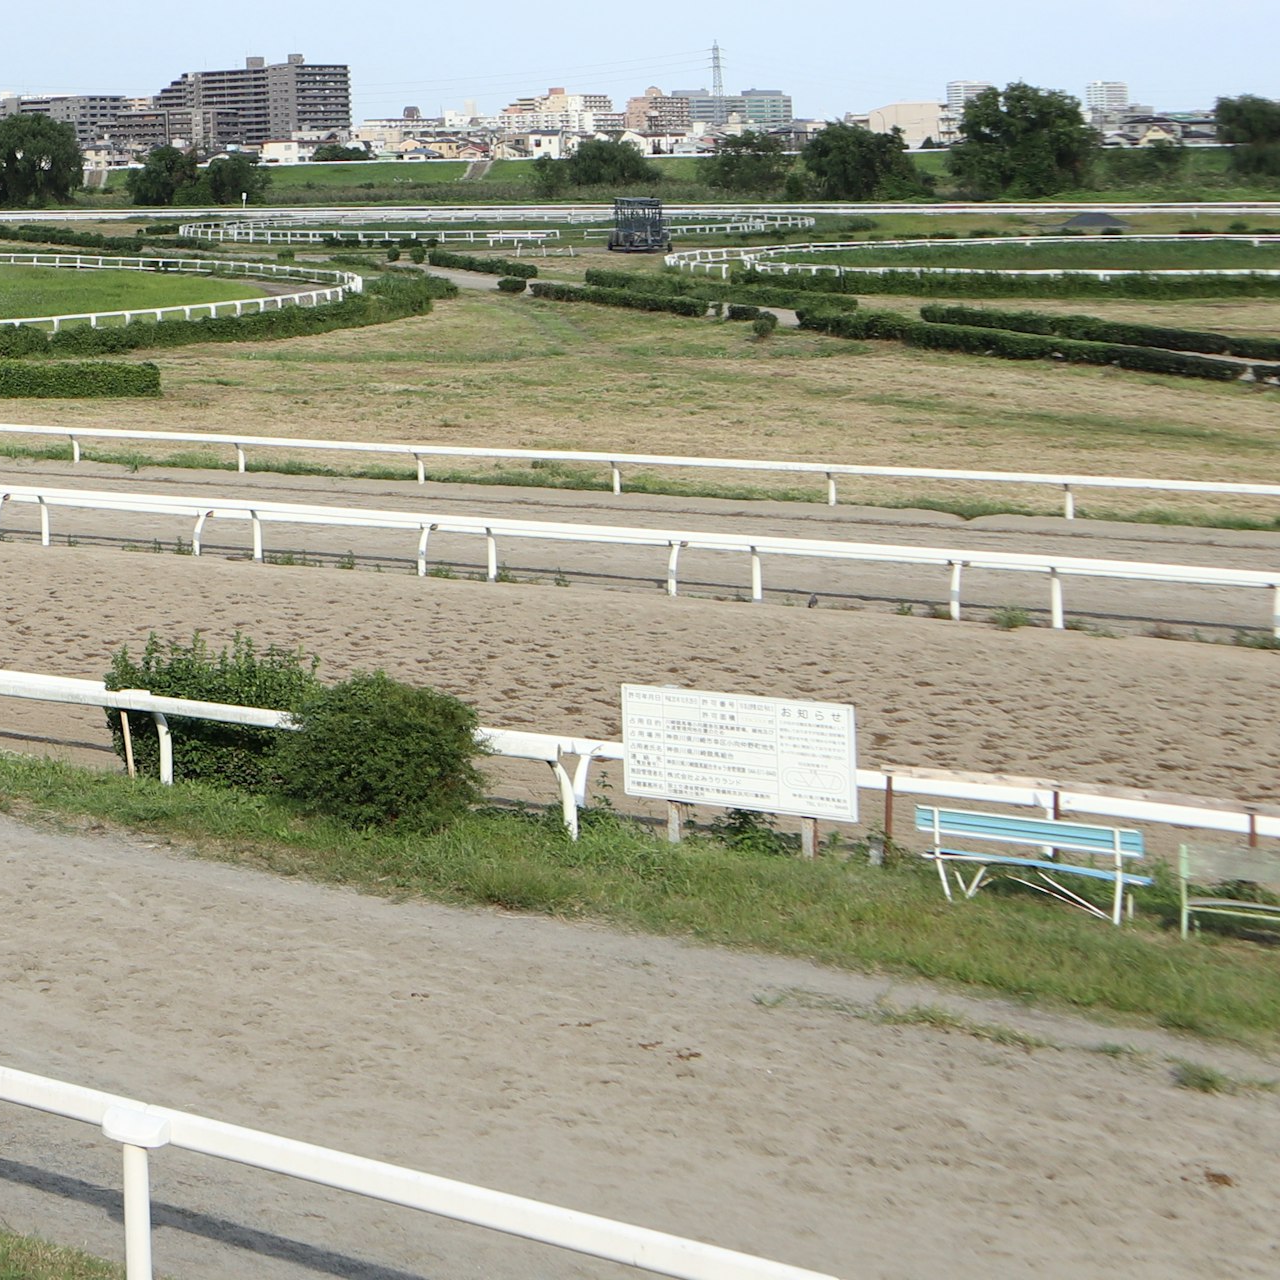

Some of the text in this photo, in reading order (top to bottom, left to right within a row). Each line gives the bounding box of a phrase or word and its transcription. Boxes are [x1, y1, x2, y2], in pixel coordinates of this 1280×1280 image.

[628, 692, 661, 701] 許可年月日
[781, 708, 842, 722] お知らせ
[629, 718, 661, 726] 占用目的
[630, 730, 661, 738] 占用場所
[667, 772, 742, 786] 株式会社よみうりランド
